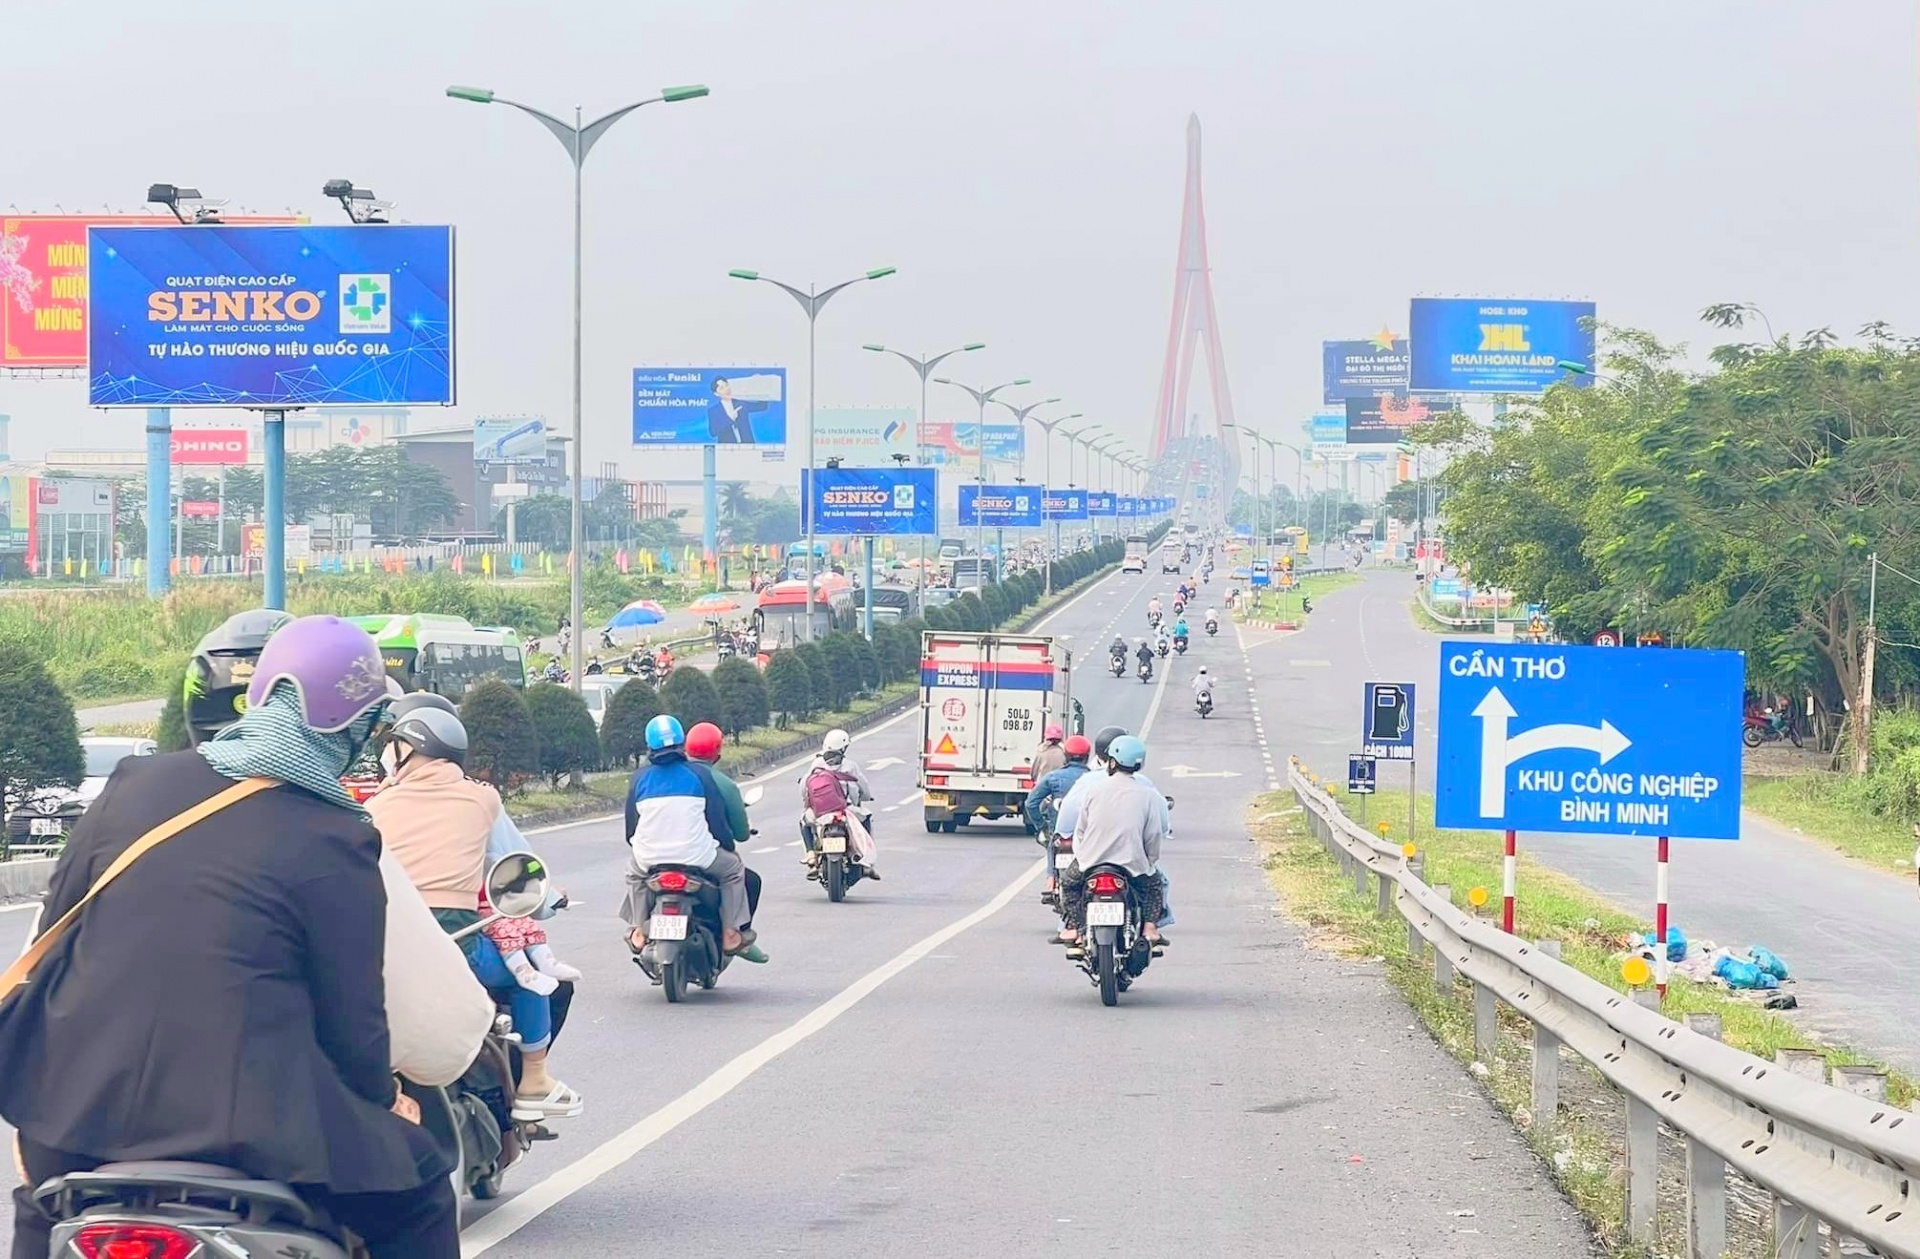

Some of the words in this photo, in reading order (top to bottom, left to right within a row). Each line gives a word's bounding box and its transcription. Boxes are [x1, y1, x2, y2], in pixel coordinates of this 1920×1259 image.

[167, 276, 201, 287] QUẠT
[204, 274, 236, 287] ĐIỆN
[238, 276, 266, 286] CAO
[268, 273, 296, 286] CẤP
[148, 290, 321, 322] SENKO
[215, 324, 238, 332] CHO
[149, 343, 167, 358] TỰ
[171, 342, 204, 356] HÀO
[208, 343, 271, 356] THƯƠNG
[276, 340, 309, 358] HIỆU
[312, 340, 358, 356] QUỐC
[362, 344, 390, 356] GIA
[1451, 354, 1482, 364] KHAI
[1484, 354, 1520, 365] HOAN
[668, 373, 701, 381] Funiki
[669, 398, 686, 406] HÒA
[688, 398, 708, 406] PHÁT
[181, 441, 243, 452] HINO
[824, 492, 888, 503] SENKO
[972, 500, 1012, 508] SENKO
[938, 662, 973, 674] NIPPON
[1450, 649, 1503, 677] CẦN
[1512, 656, 1566, 679] THƠ
[938, 674, 978, 686] EXPRESS
[1008, 708, 1030, 720] 50LD
[1003, 720, 1033, 731] 098.87
[1364, 742, 1387, 758] CÁCH
[1519, 770, 1563, 792] KHU
[1571, 767, 1633, 794] CÔNG
[1640, 772, 1718, 803] NGHIỆP
[1561, 795, 1609, 822] BÌNH
[1616, 802, 1669, 825] MINH
